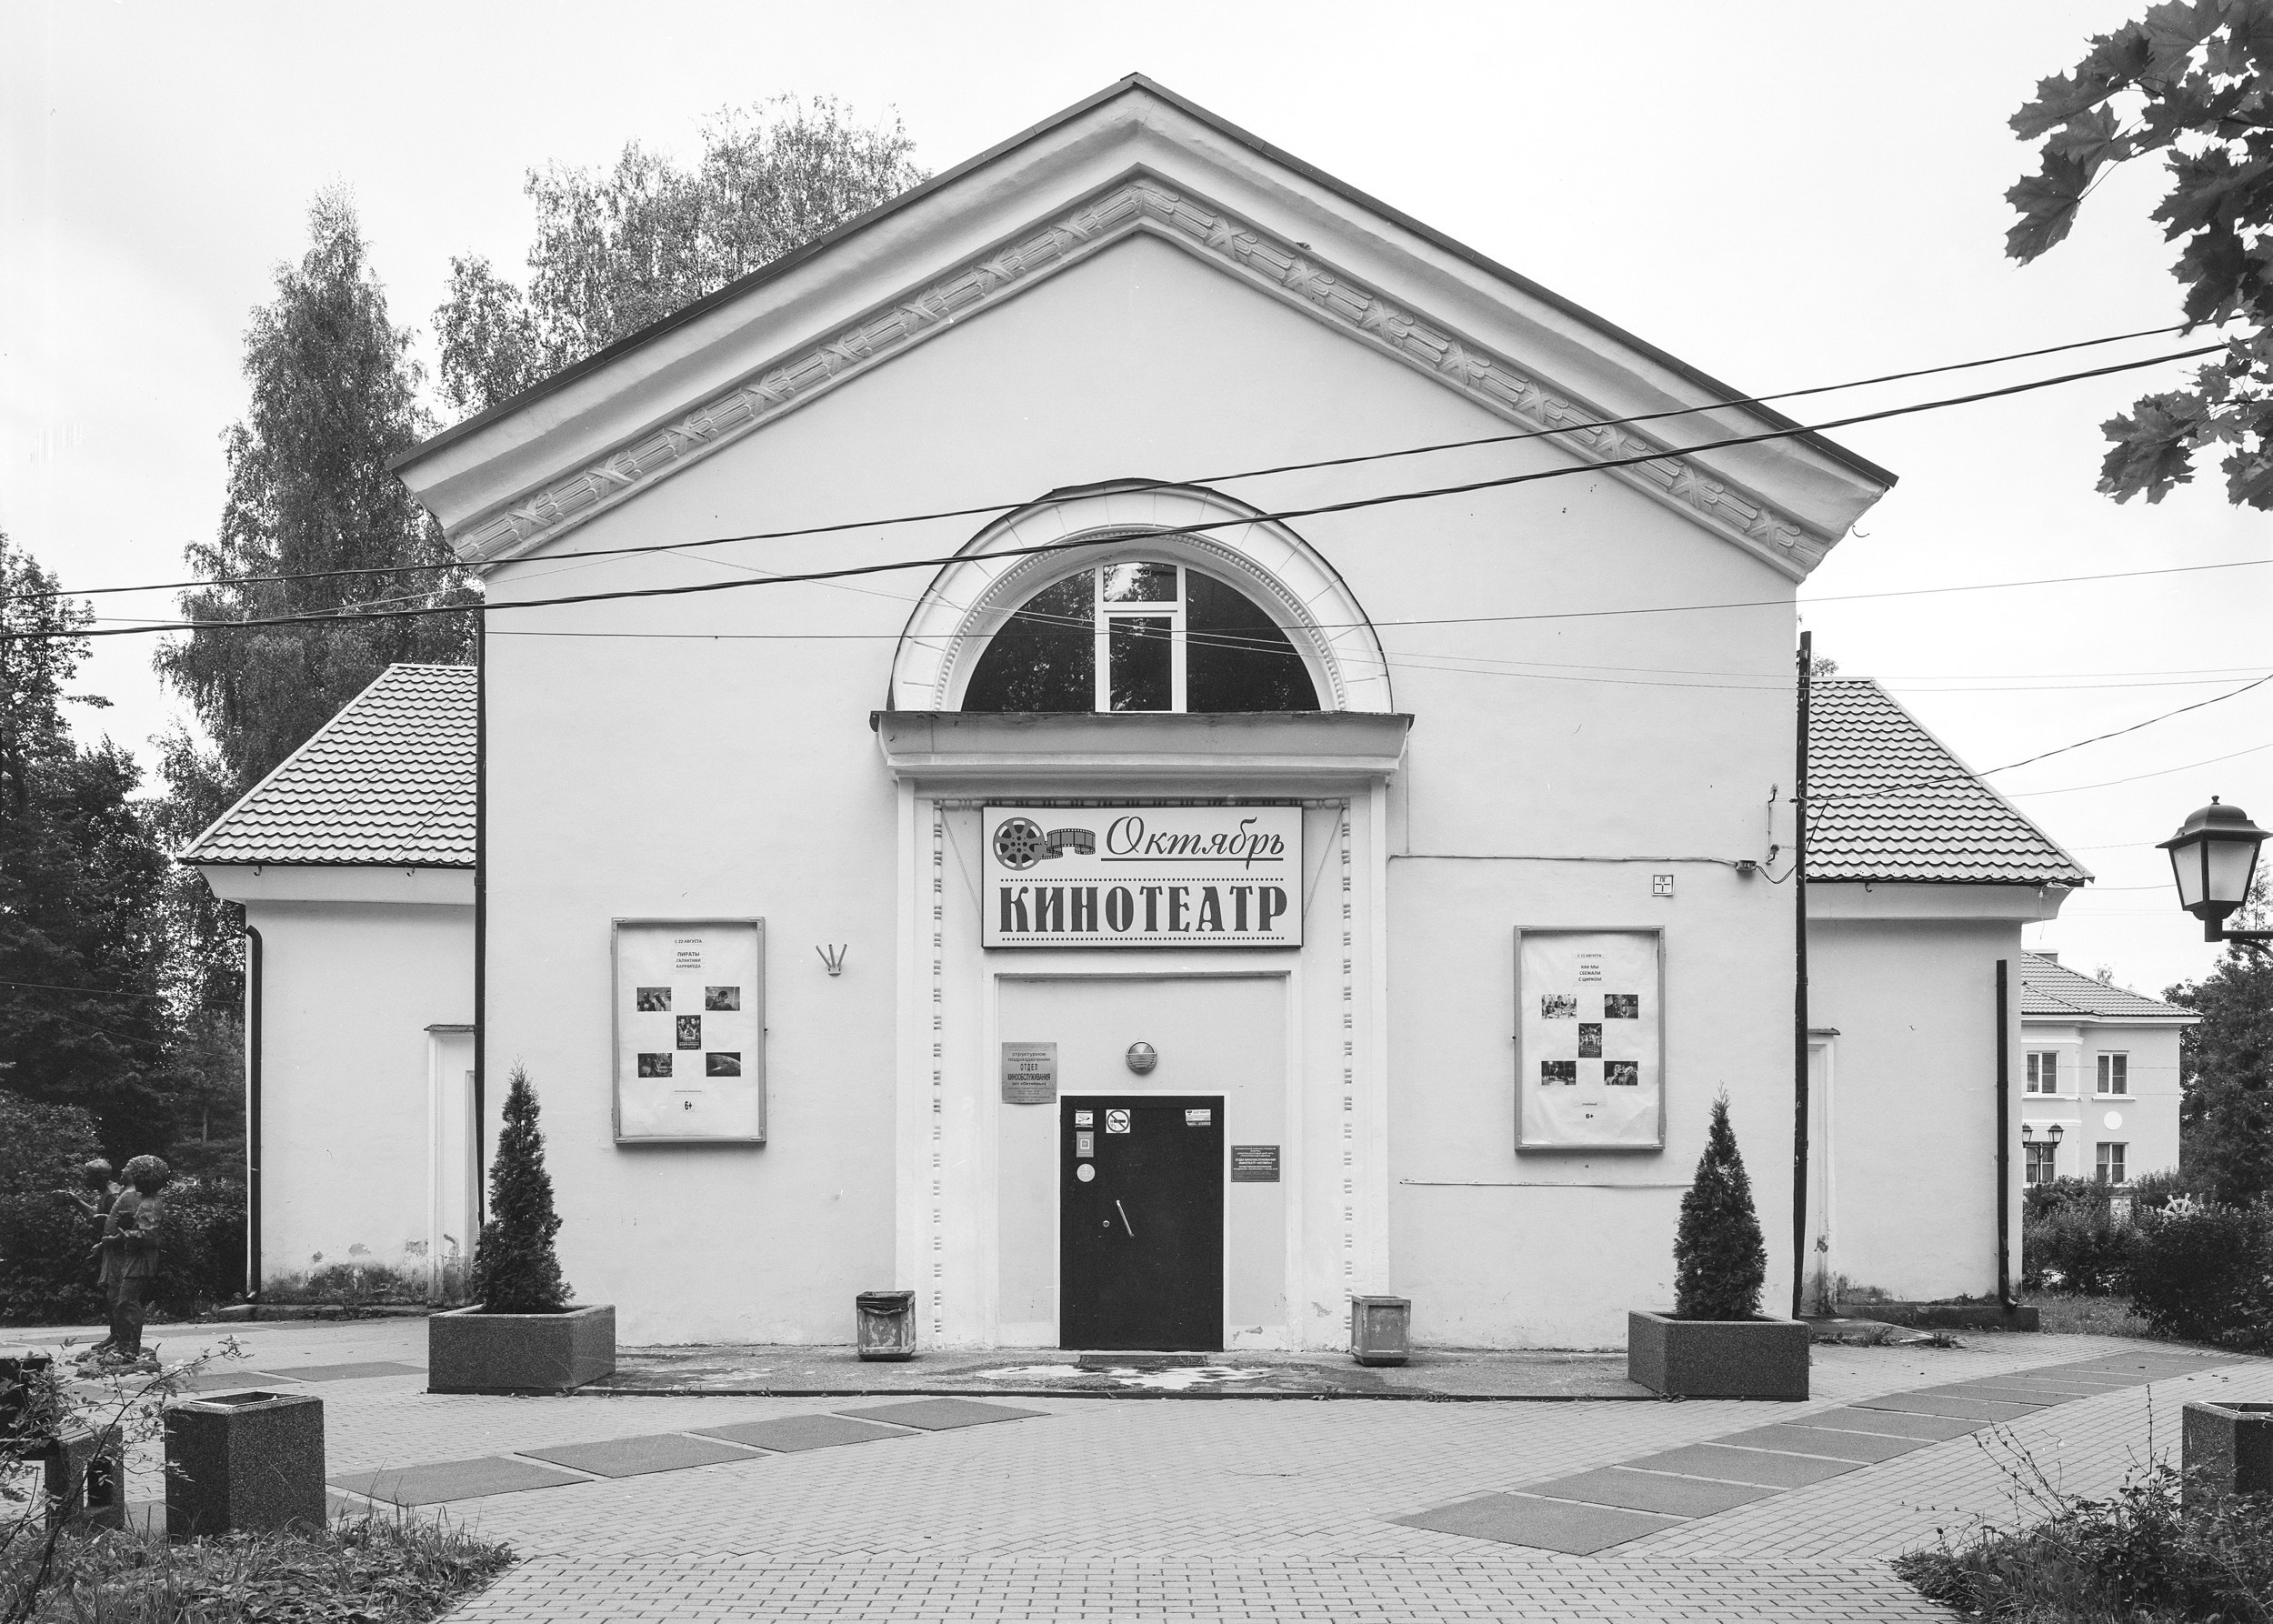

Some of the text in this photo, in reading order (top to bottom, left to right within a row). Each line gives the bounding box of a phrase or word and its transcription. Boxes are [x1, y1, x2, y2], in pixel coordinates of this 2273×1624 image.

[1106, 816, 1285, 870] Октябрь
[999, 885, 1287, 933] КИНОТЕАТР
[1019, 1063, 1038, 1071] ОТДЕЛ
[1007, 1073, 1051, 1081] КИНООБСЛУЖИВАНИЯ
[685, 1100, 693, 1110] 6+
